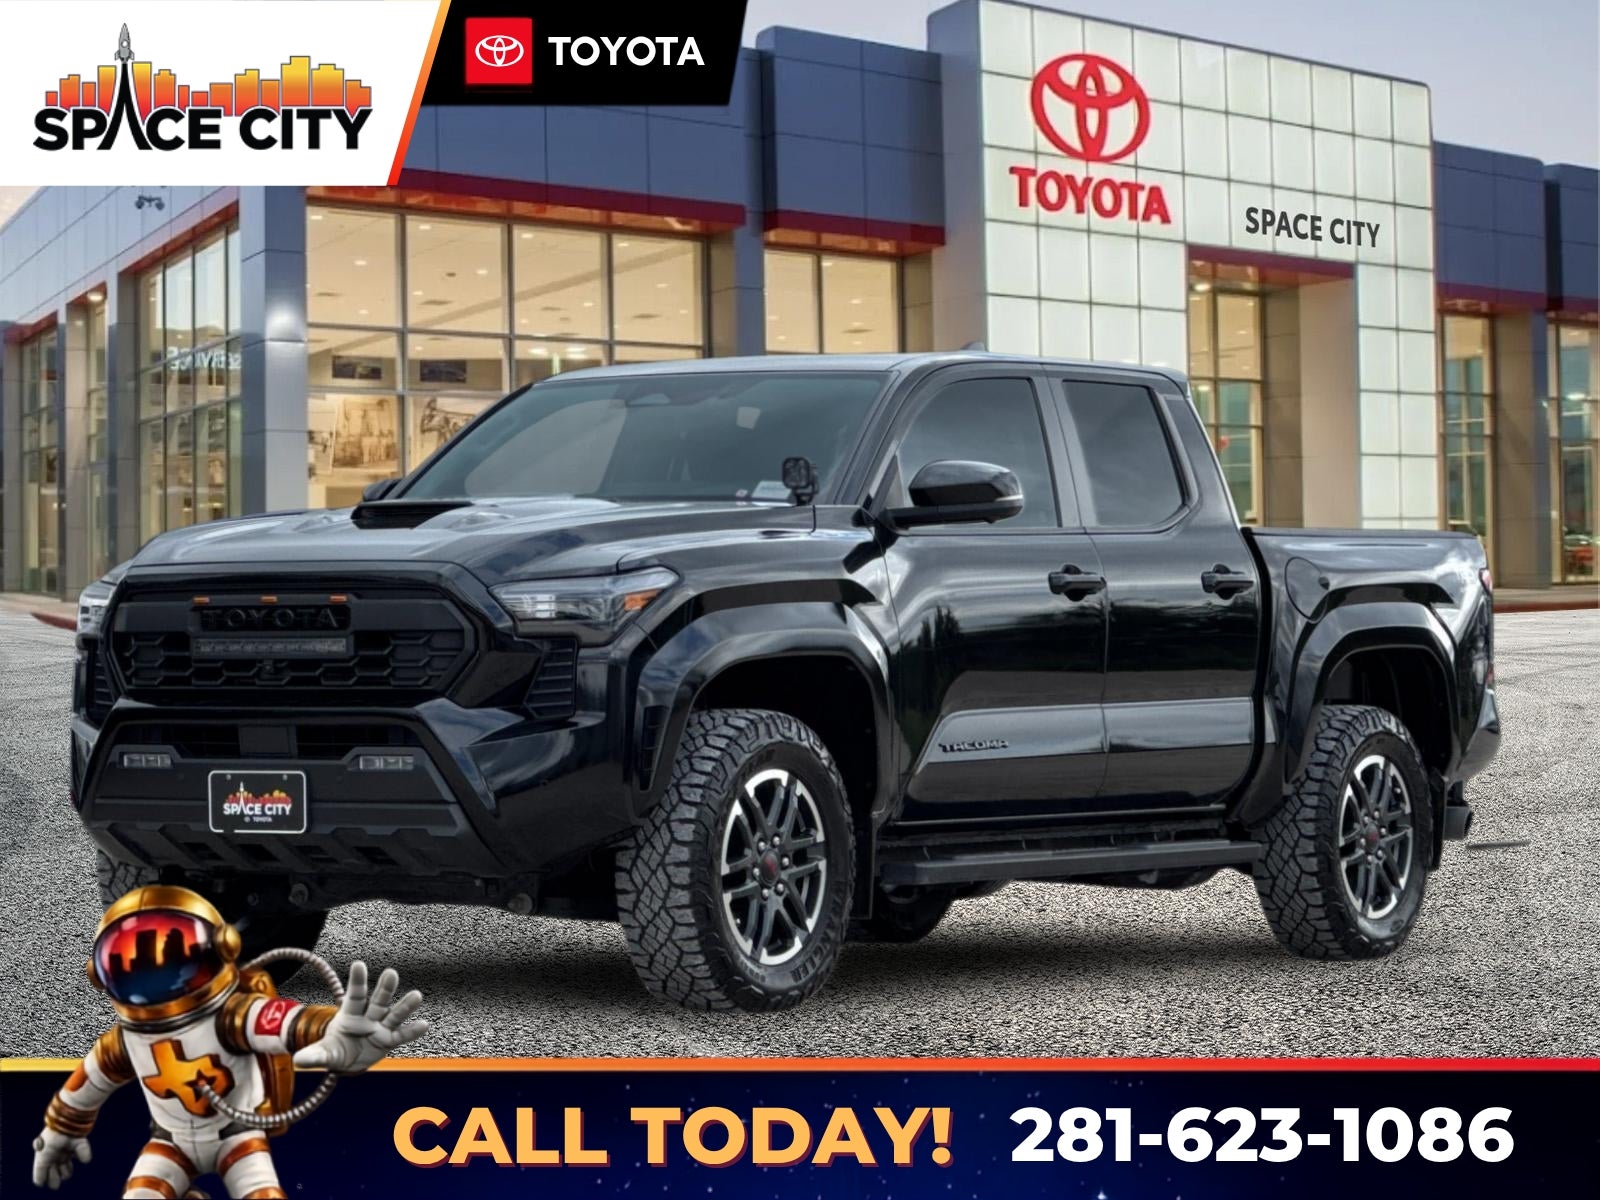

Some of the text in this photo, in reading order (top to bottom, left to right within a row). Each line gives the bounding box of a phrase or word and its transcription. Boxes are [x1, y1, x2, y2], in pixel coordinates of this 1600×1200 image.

[1009, 166, 1172, 225] TOYOTA
[1245, 206, 1381, 248] SPACE CITY
[202, 607, 338, 629] TOYOTA
[938, 739, 1009, 753] TACOMA
[223, 796, 292, 815] SPACE CITY
